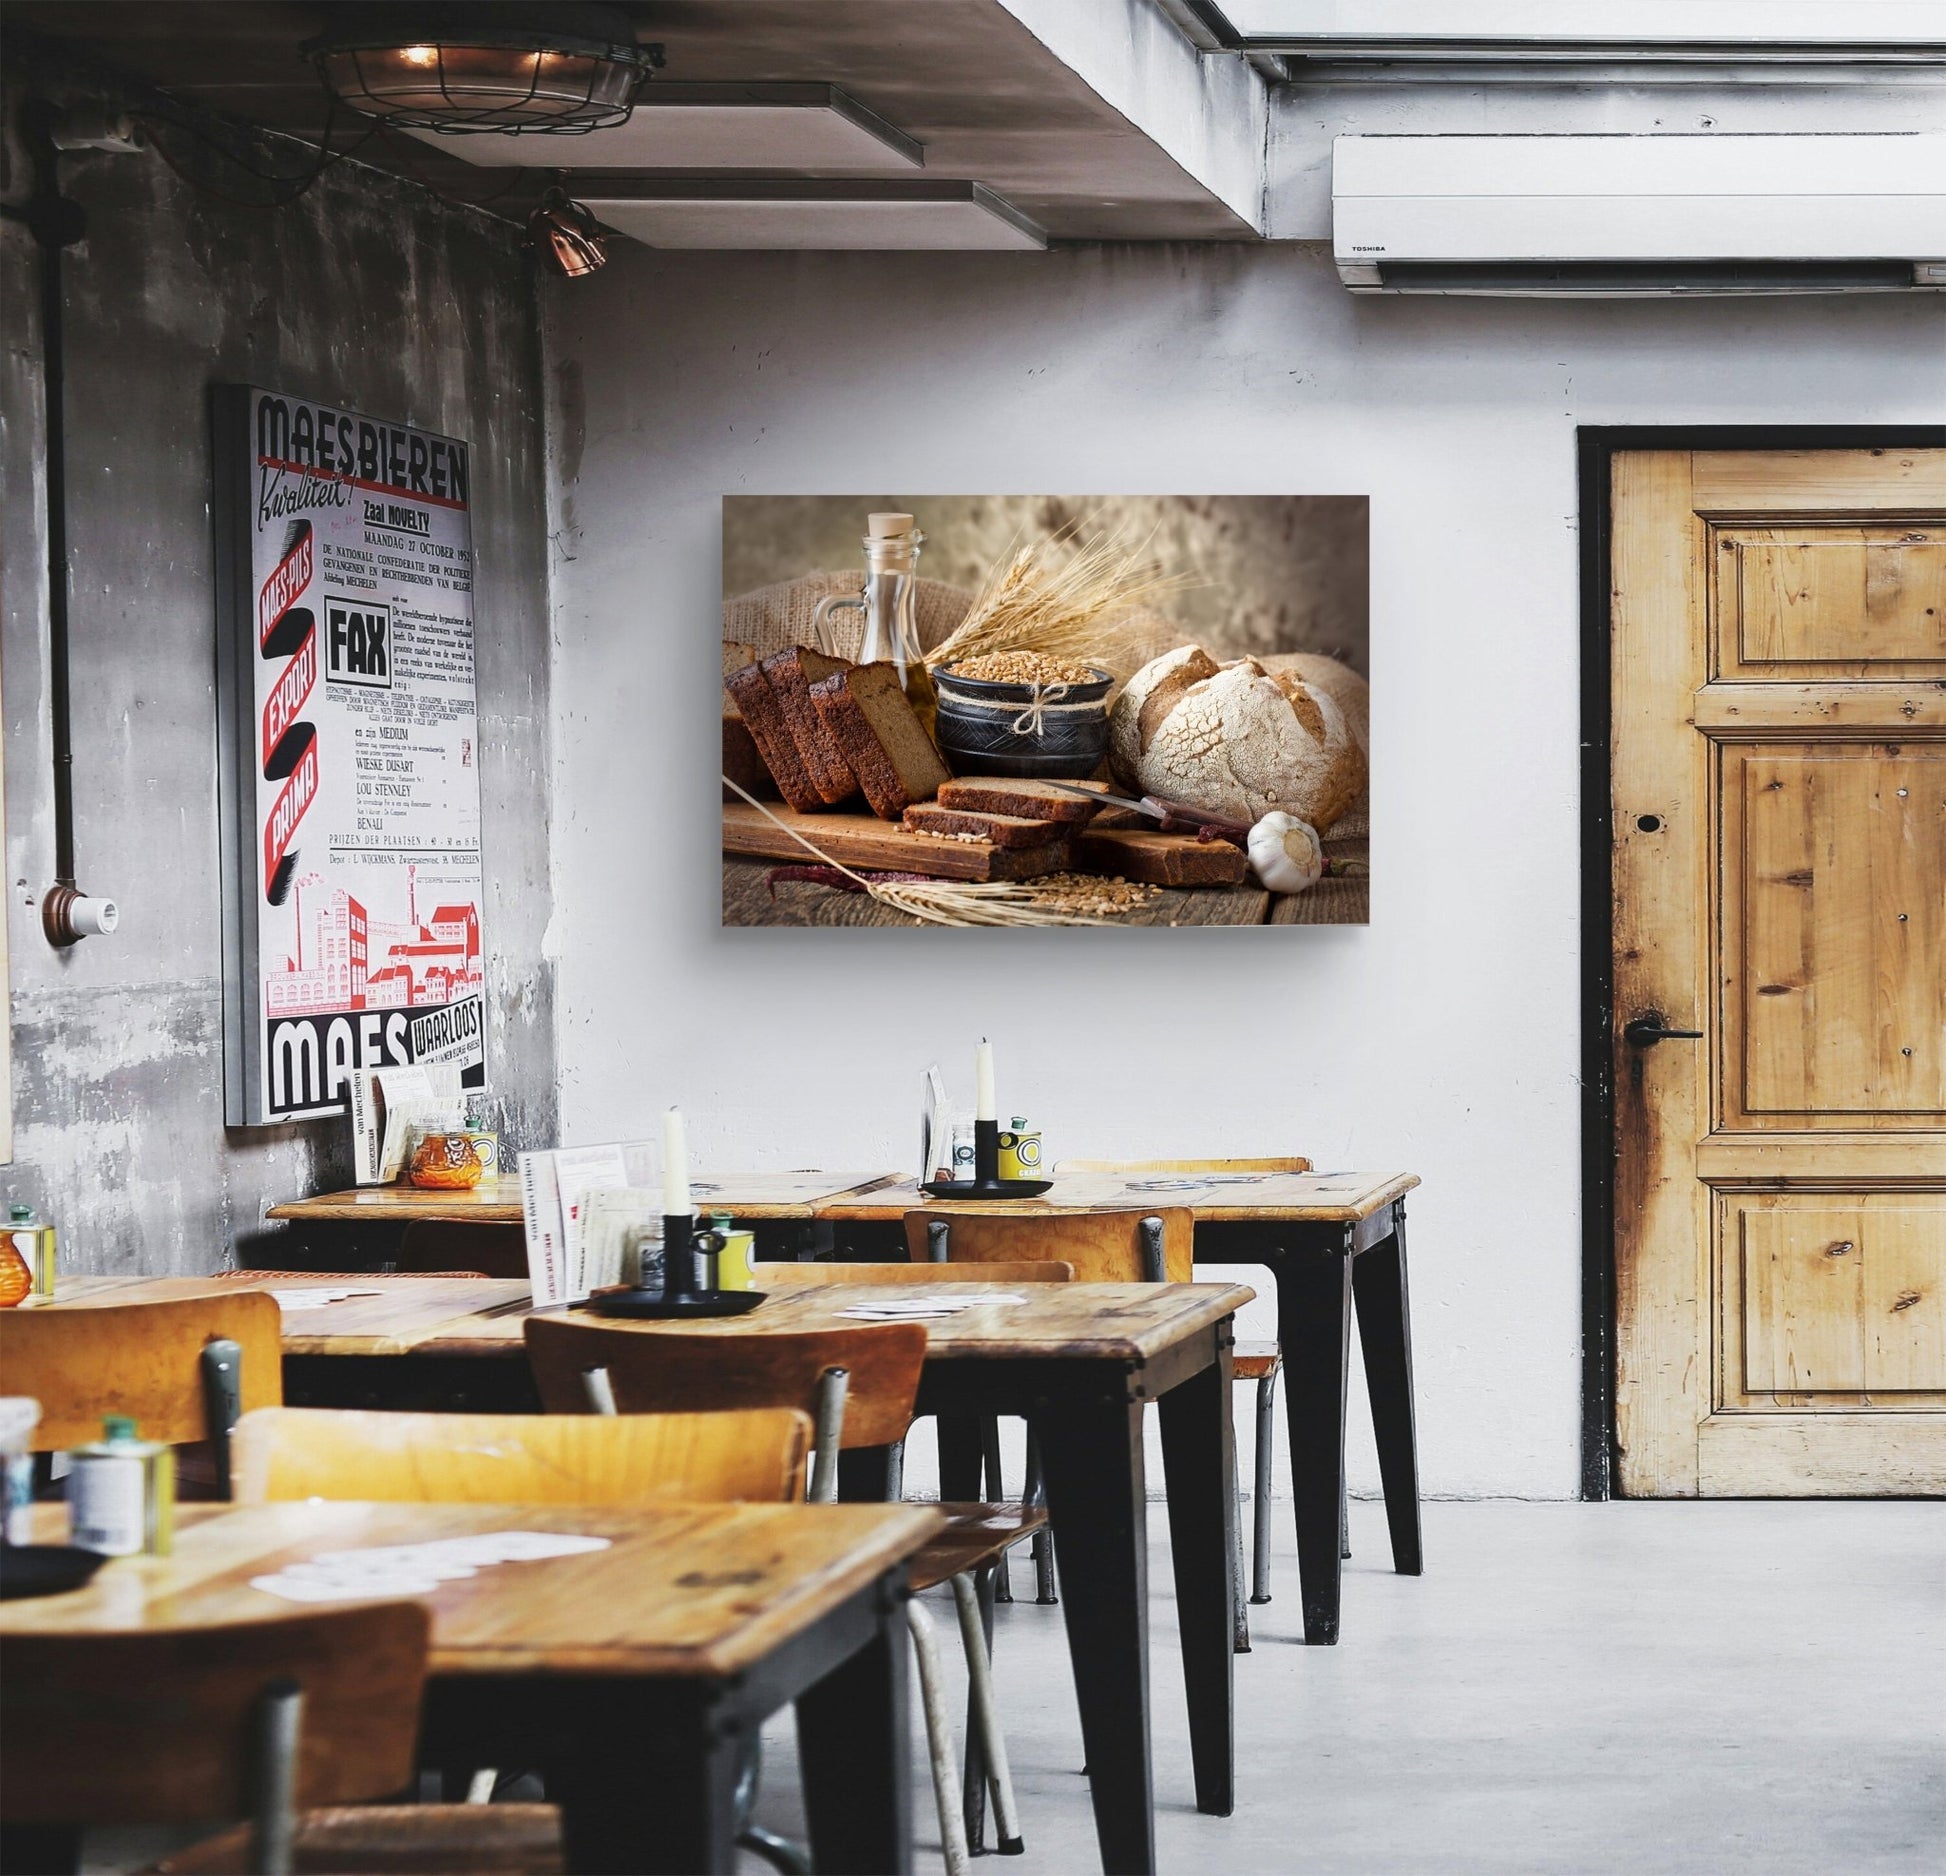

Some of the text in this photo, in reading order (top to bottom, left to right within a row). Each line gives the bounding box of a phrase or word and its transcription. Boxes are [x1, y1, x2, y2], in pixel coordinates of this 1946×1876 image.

[258, 461, 357, 532] Kwaliteit!
[364, 500, 430, 532] Zaal NOVELTY
[323, 544, 471, 580] DE NATIONALE CONFEDERATIE DER POLITIEKE
[364, 531, 404, 550] MAANDAG
[408, 540, 416, 552] 27
[420, 542, 454, 559] OCTOBER
[262, 539, 310, 637] MAES-PILS
[323, 558, 365, 574] GEVANGENEN
[369, 566, 378, 576] EN
[381, 568, 434, 586] RECHTHEBBENDEN
[437, 578, 449, 589] VAN
[346, 575, 378, 589] MECHELEN
[330, 608, 387, 677] FAX
[269, 635, 314, 747] EXPORT
[380, 726, 408, 740] MEDIUM
[356, 757, 414, 773] WIESKE DUSART
[357, 782, 411, 797] LOU STENNLEY
[272, 752, 314, 862] PRIMA
[329, 834, 361, 846] PRIJZEN
[364, 834, 379, 845] DER
[384, 835, 421, 846] PLAATSEN
[413, 1000, 477, 1057] WAARLOOS
[354, 1072, 365, 1135] van Mechelen
